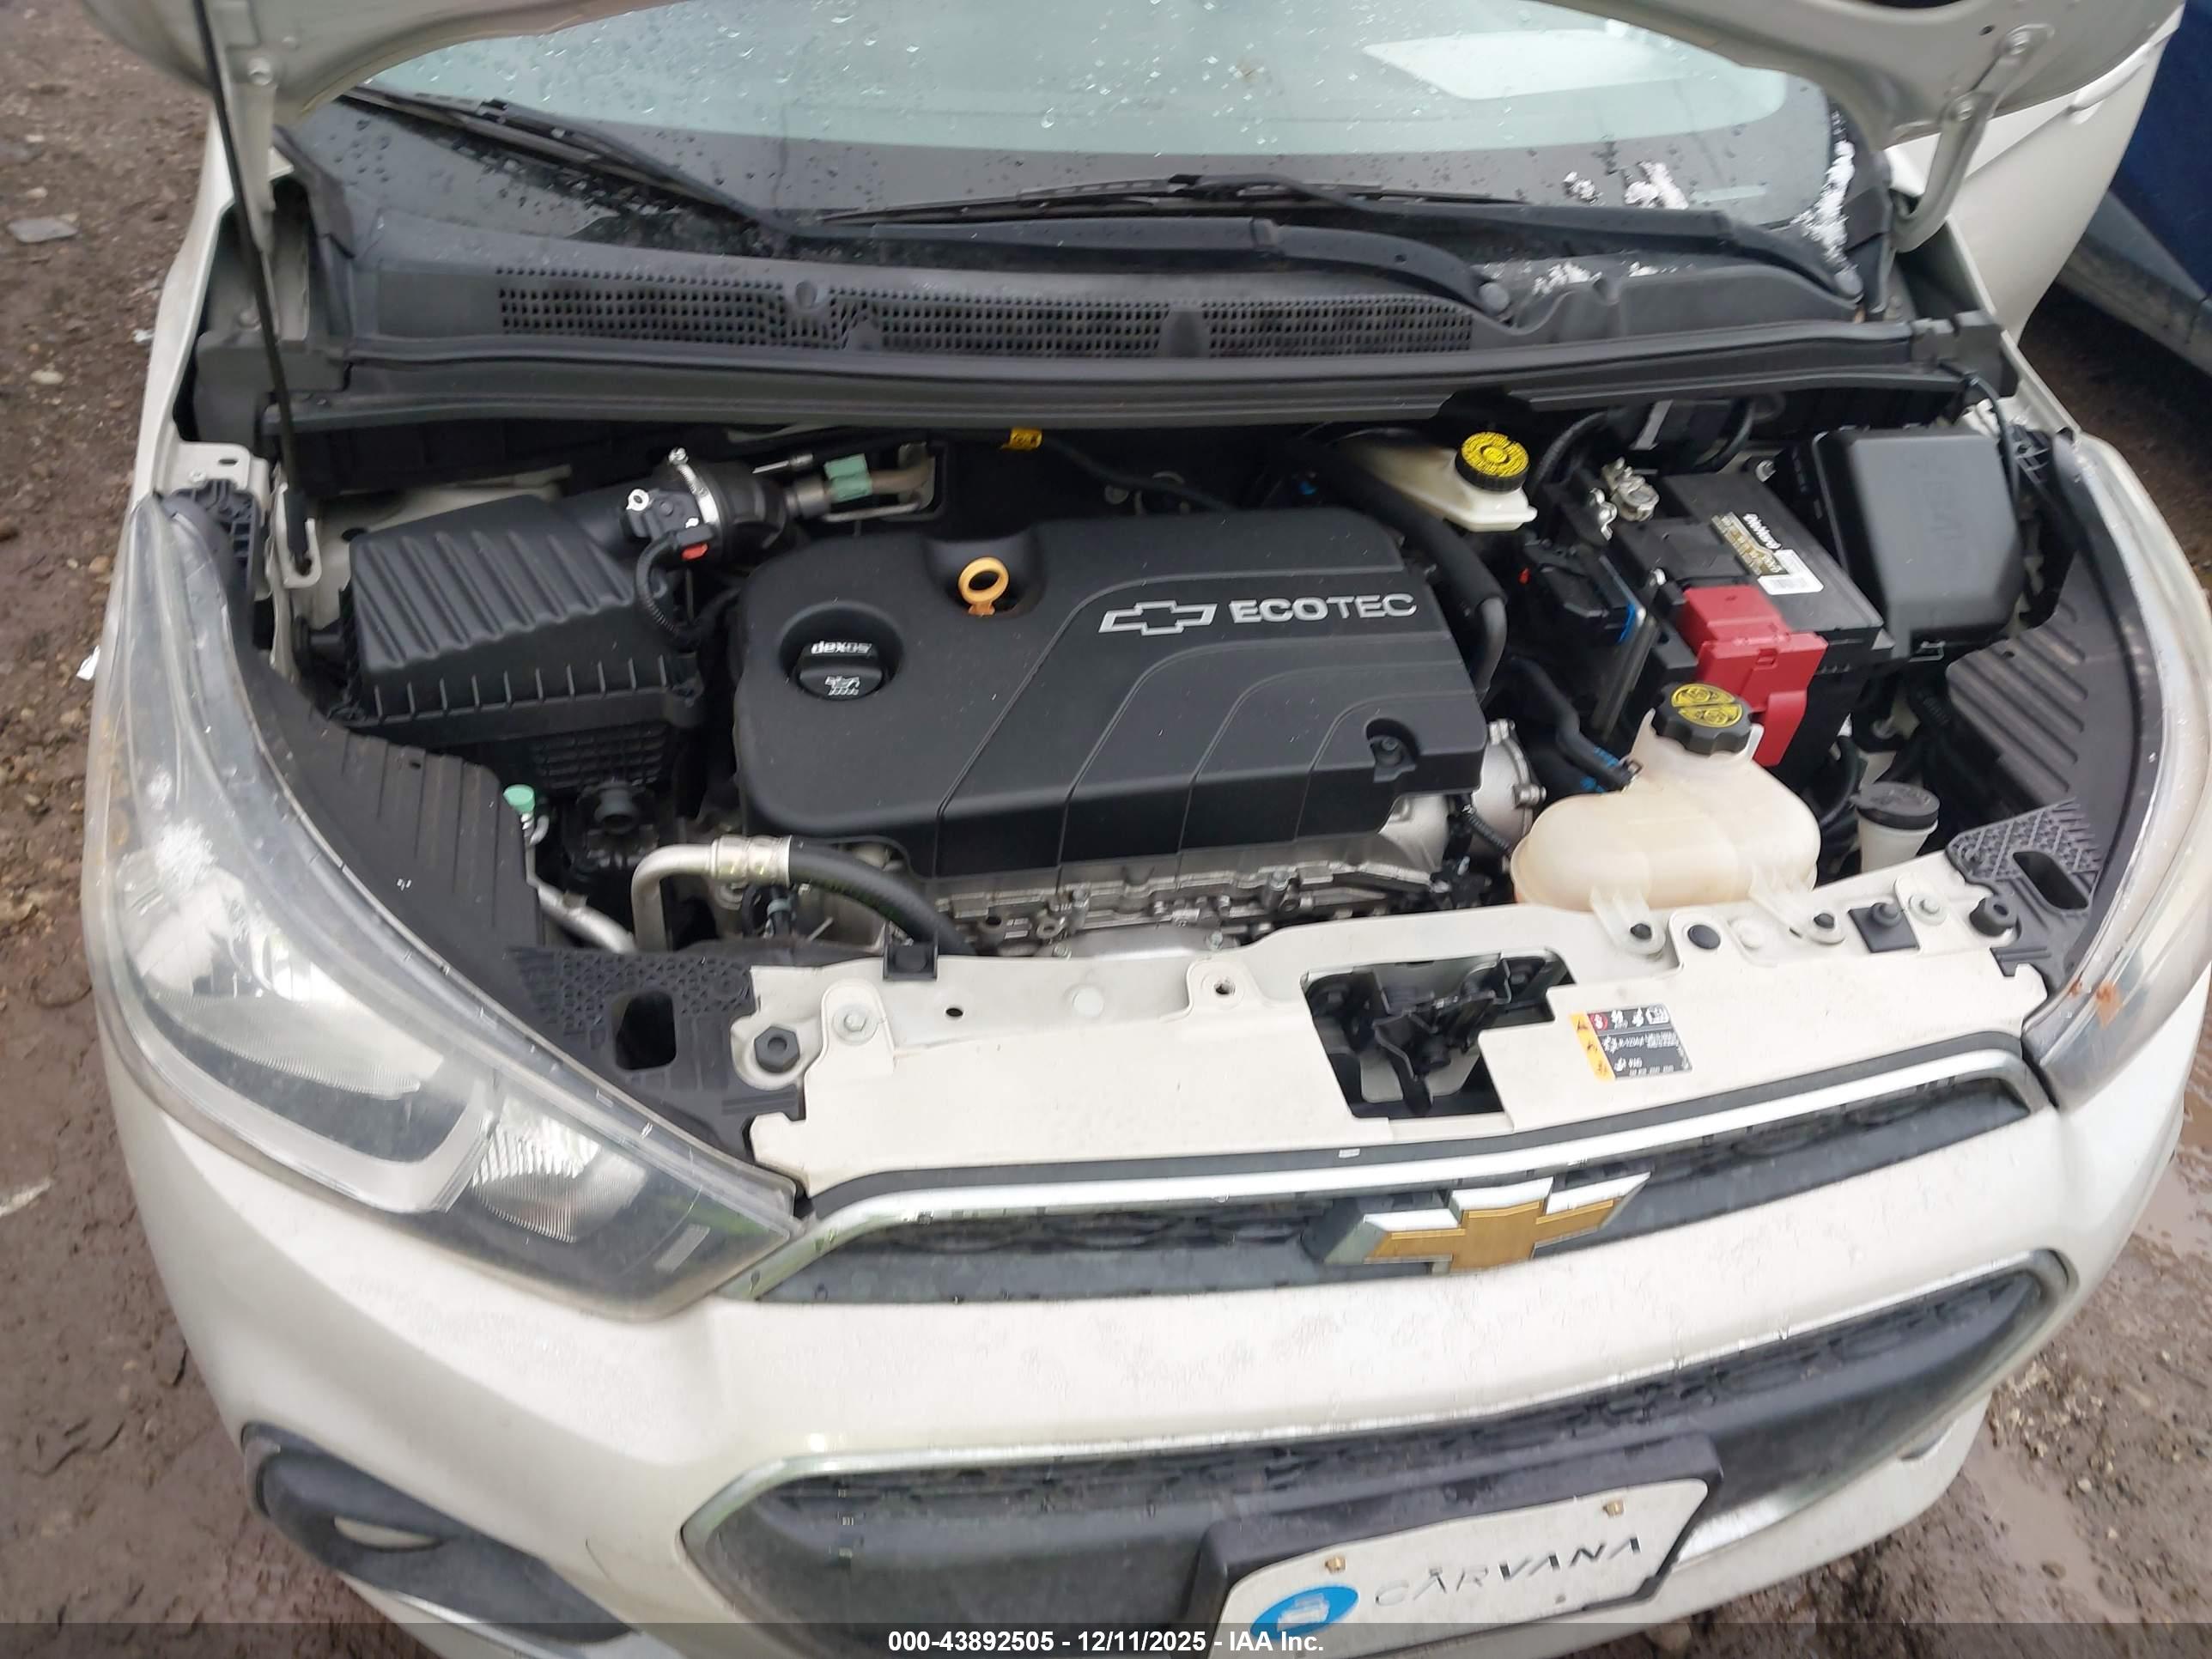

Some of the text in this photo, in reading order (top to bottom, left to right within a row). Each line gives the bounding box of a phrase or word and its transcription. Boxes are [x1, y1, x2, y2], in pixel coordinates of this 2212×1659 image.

[1228, 593, 1417, 623] ECOTEC
[811, 641, 872, 654] dexos
[1374, 1536, 1641, 1606] CARVANA
